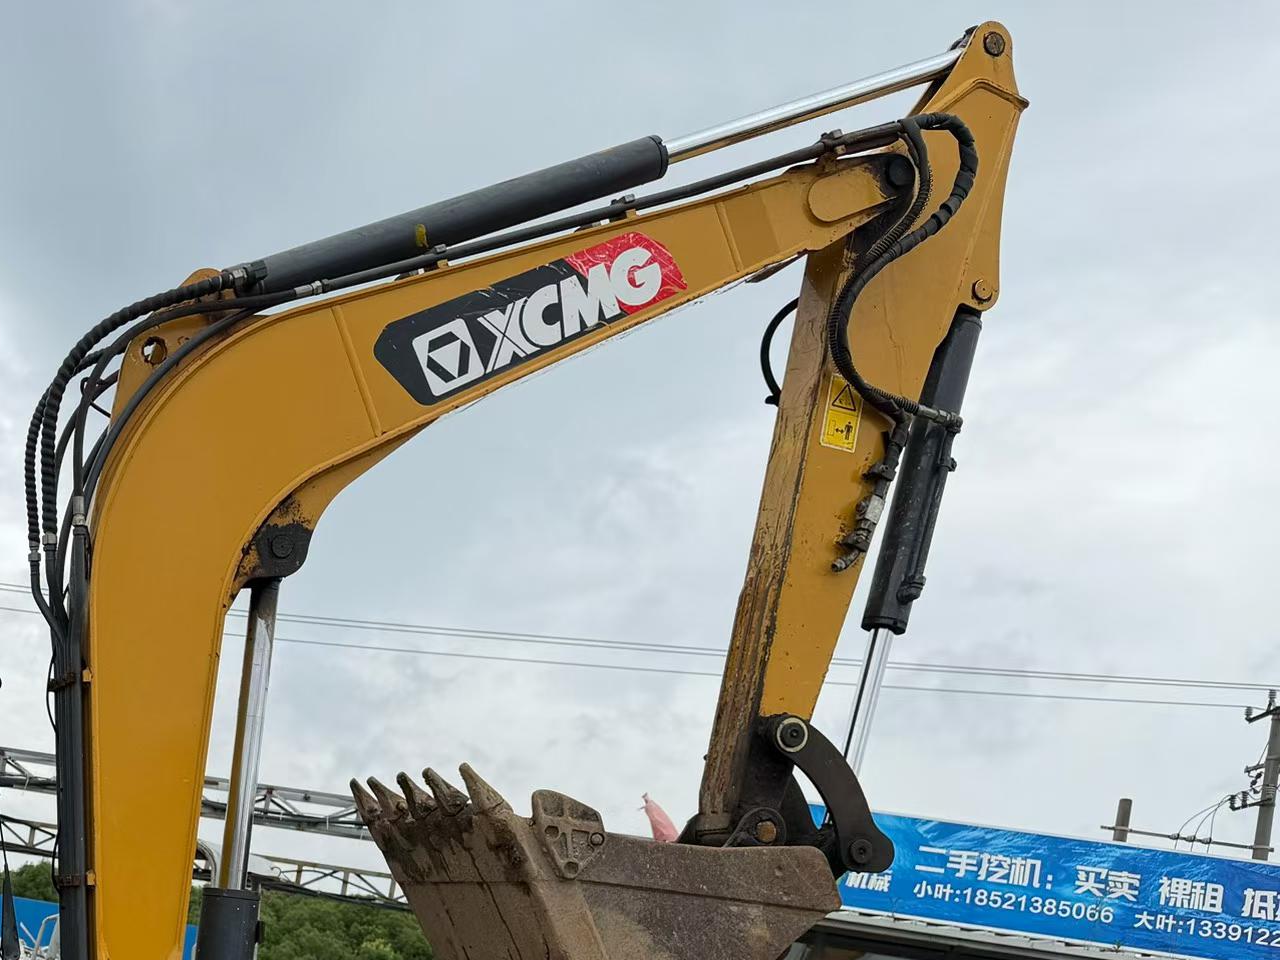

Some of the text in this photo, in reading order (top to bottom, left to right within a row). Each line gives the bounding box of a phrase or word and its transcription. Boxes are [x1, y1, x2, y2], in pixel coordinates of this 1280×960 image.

[477, 247, 663, 374] XCMG
[845, 871, 893, 892] 机械
[913, 880, 1115, 925] 小叶:18521385066
[1073, 865, 1141, 902] 买卖
[1158, 876, 1224, 913] 裸租
[1241, 888, 1280, 921] 抵
